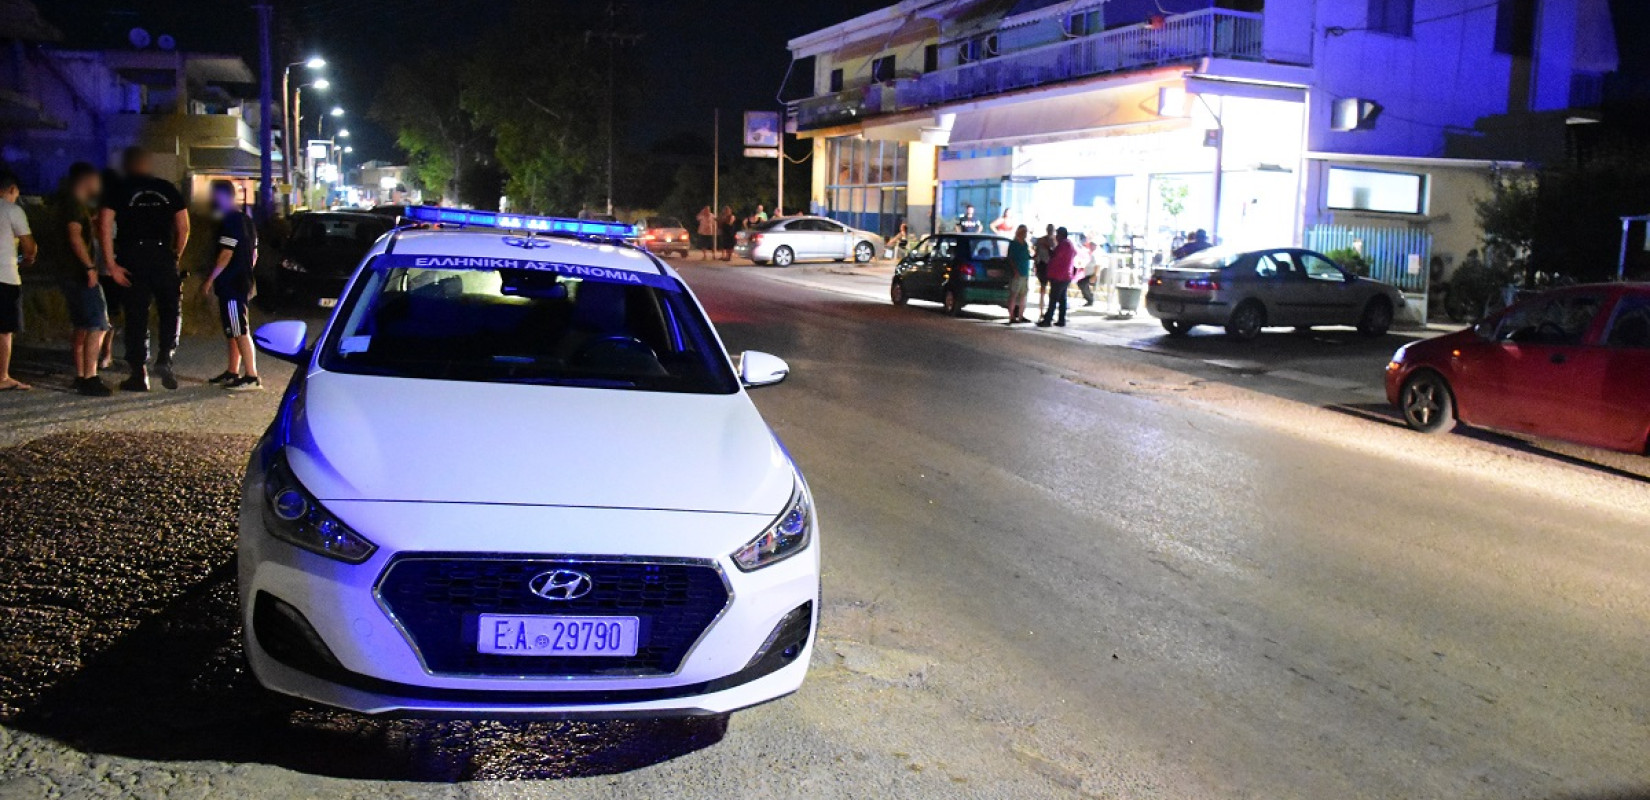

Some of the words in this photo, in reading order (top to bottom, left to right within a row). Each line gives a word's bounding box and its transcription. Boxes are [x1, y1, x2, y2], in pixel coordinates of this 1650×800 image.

[415, 257, 518, 268] ΕΛΛΗΝΙΚΗ
[524, 261, 642, 283] ΑΣΤΥΝΟΜΙΑ
[552, 622, 621, 650] 29790
